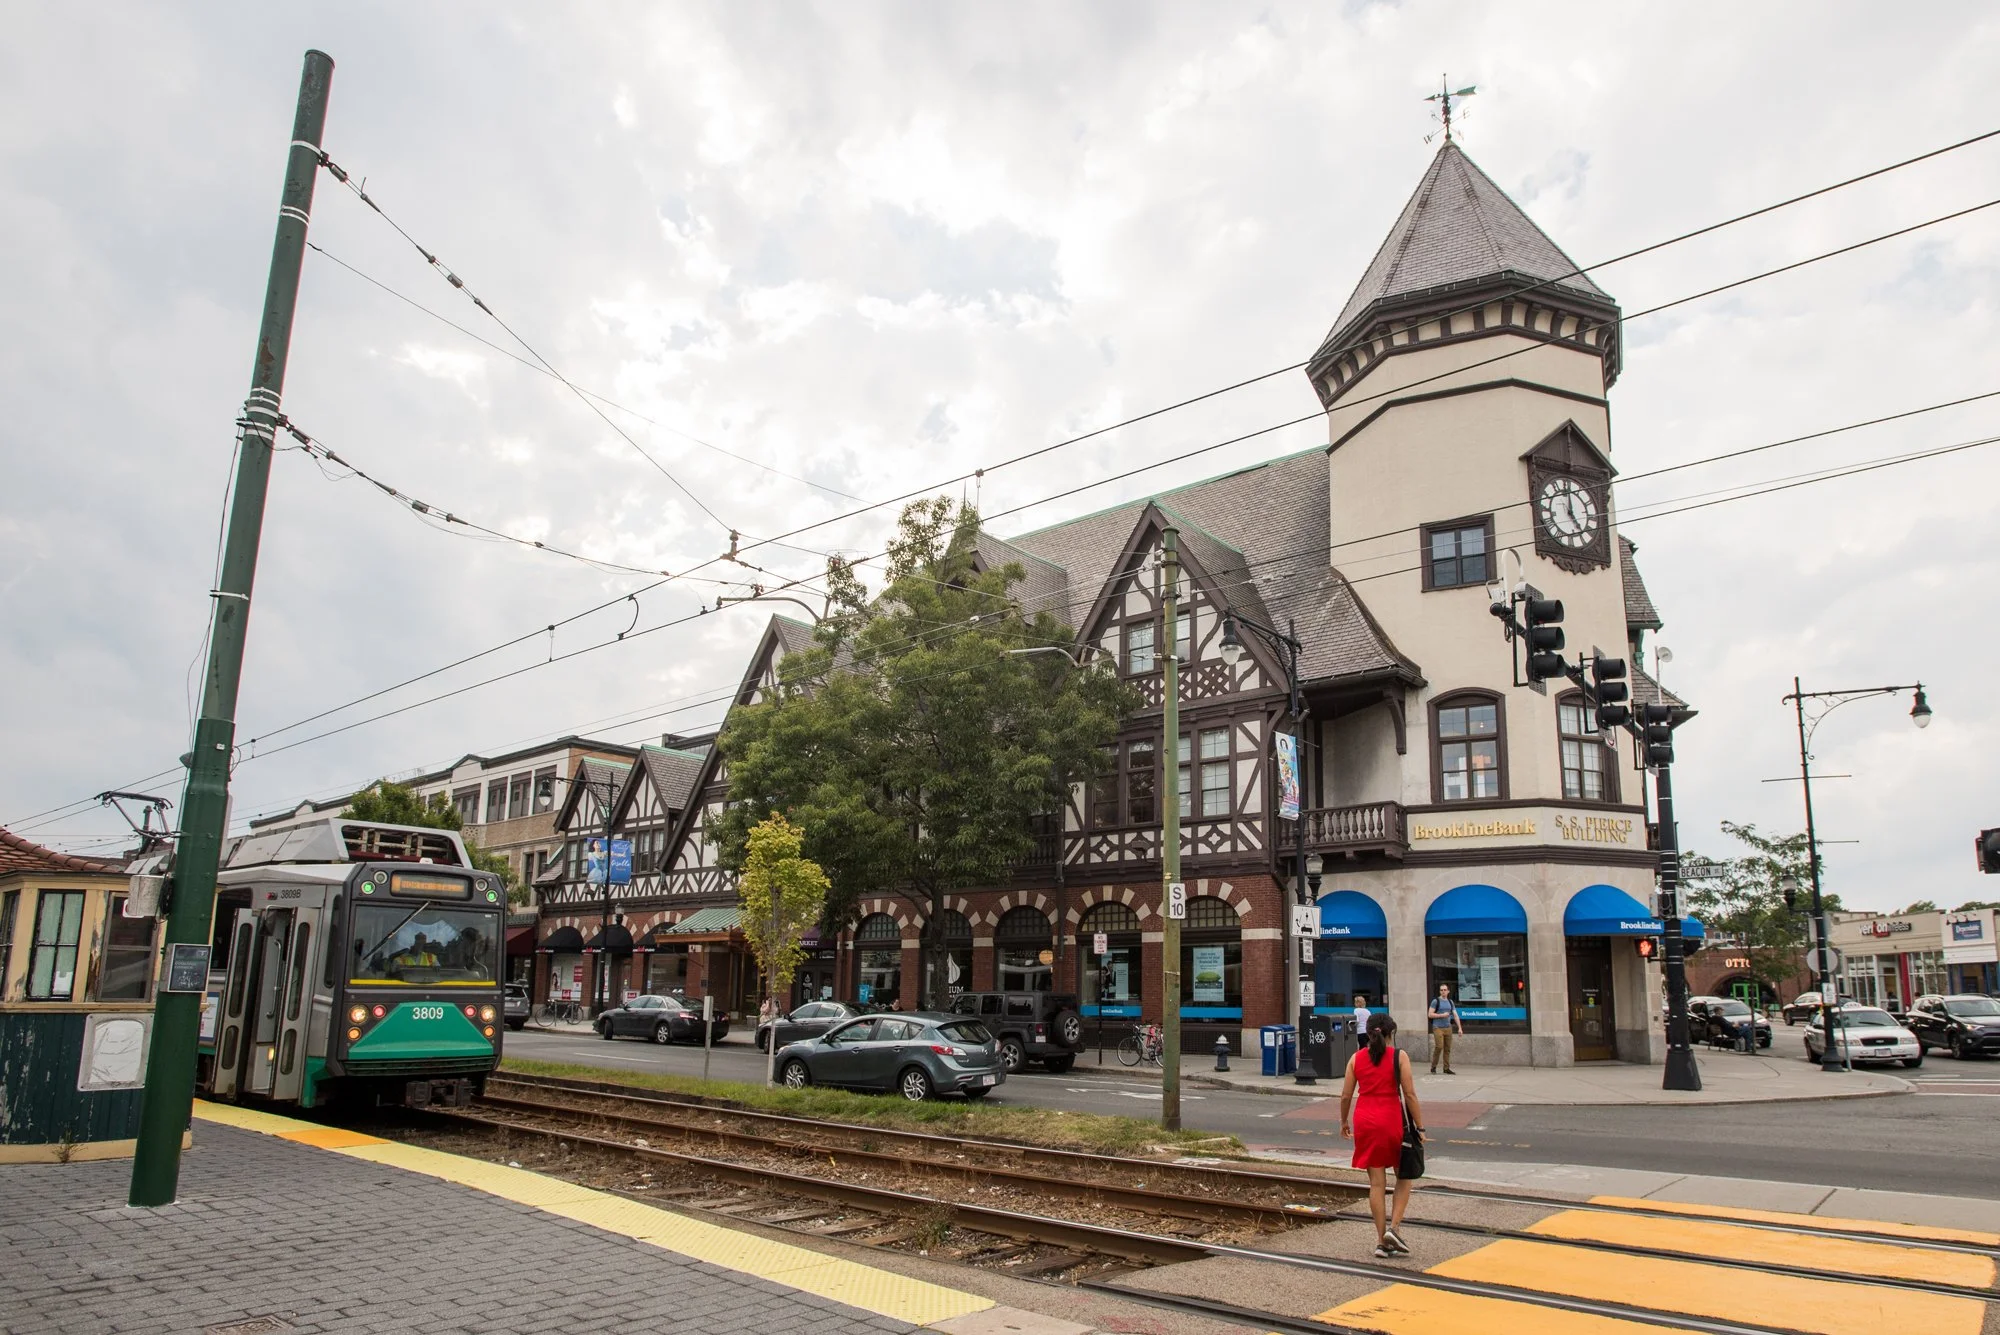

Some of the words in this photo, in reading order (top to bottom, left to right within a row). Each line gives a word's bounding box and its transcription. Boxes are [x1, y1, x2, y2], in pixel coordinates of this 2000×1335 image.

[1414, 819, 1536, 840] BrooklineBank
[1585, 816, 1633, 833] PIERCE
[1562, 826, 1628, 844] BUILDING
[1681, 867, 1711, 878] BEACON
[1172, 886, 1182, 900] S
[1171, 903, 1184, 916] 10
[1321, 926, 1351, 935] lineBank
[412, 1007, 444, 1020] 3809
